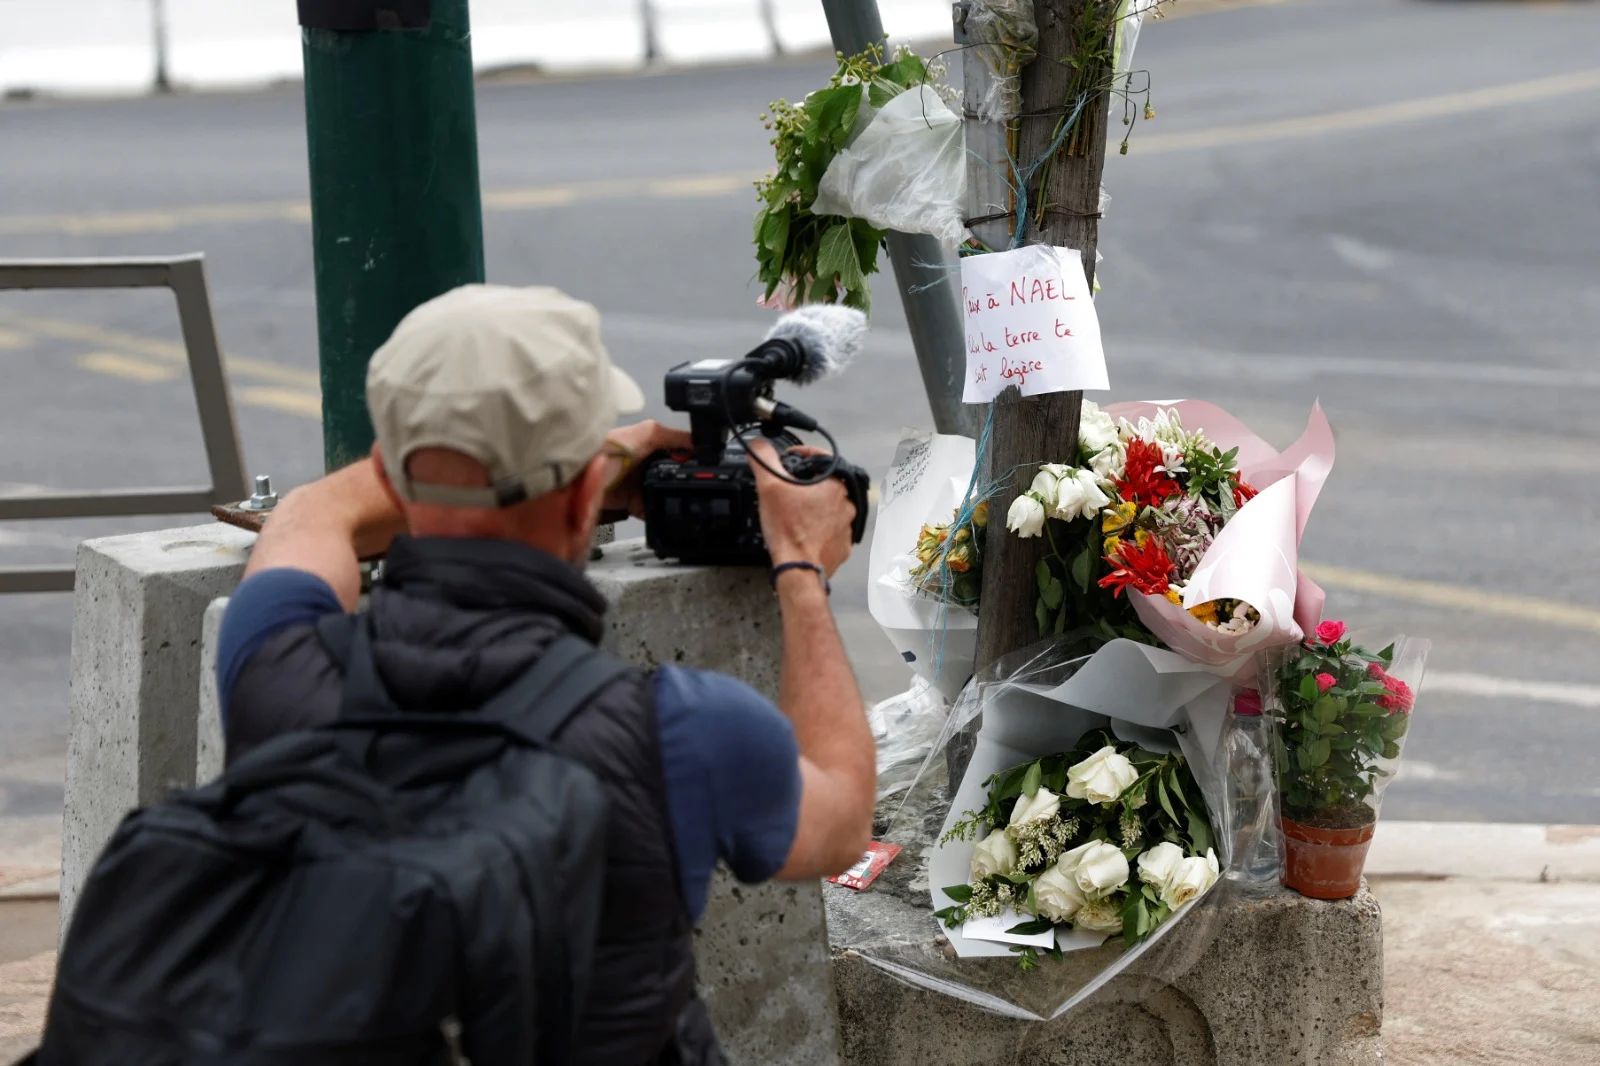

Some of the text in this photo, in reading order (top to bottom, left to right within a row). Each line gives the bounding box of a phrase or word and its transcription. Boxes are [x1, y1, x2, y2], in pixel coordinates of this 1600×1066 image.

[1010, 276, 1076, 306] NAEL
[1004, 327, 1042, 348] terre
[1054, 318, 1075, 338] te
